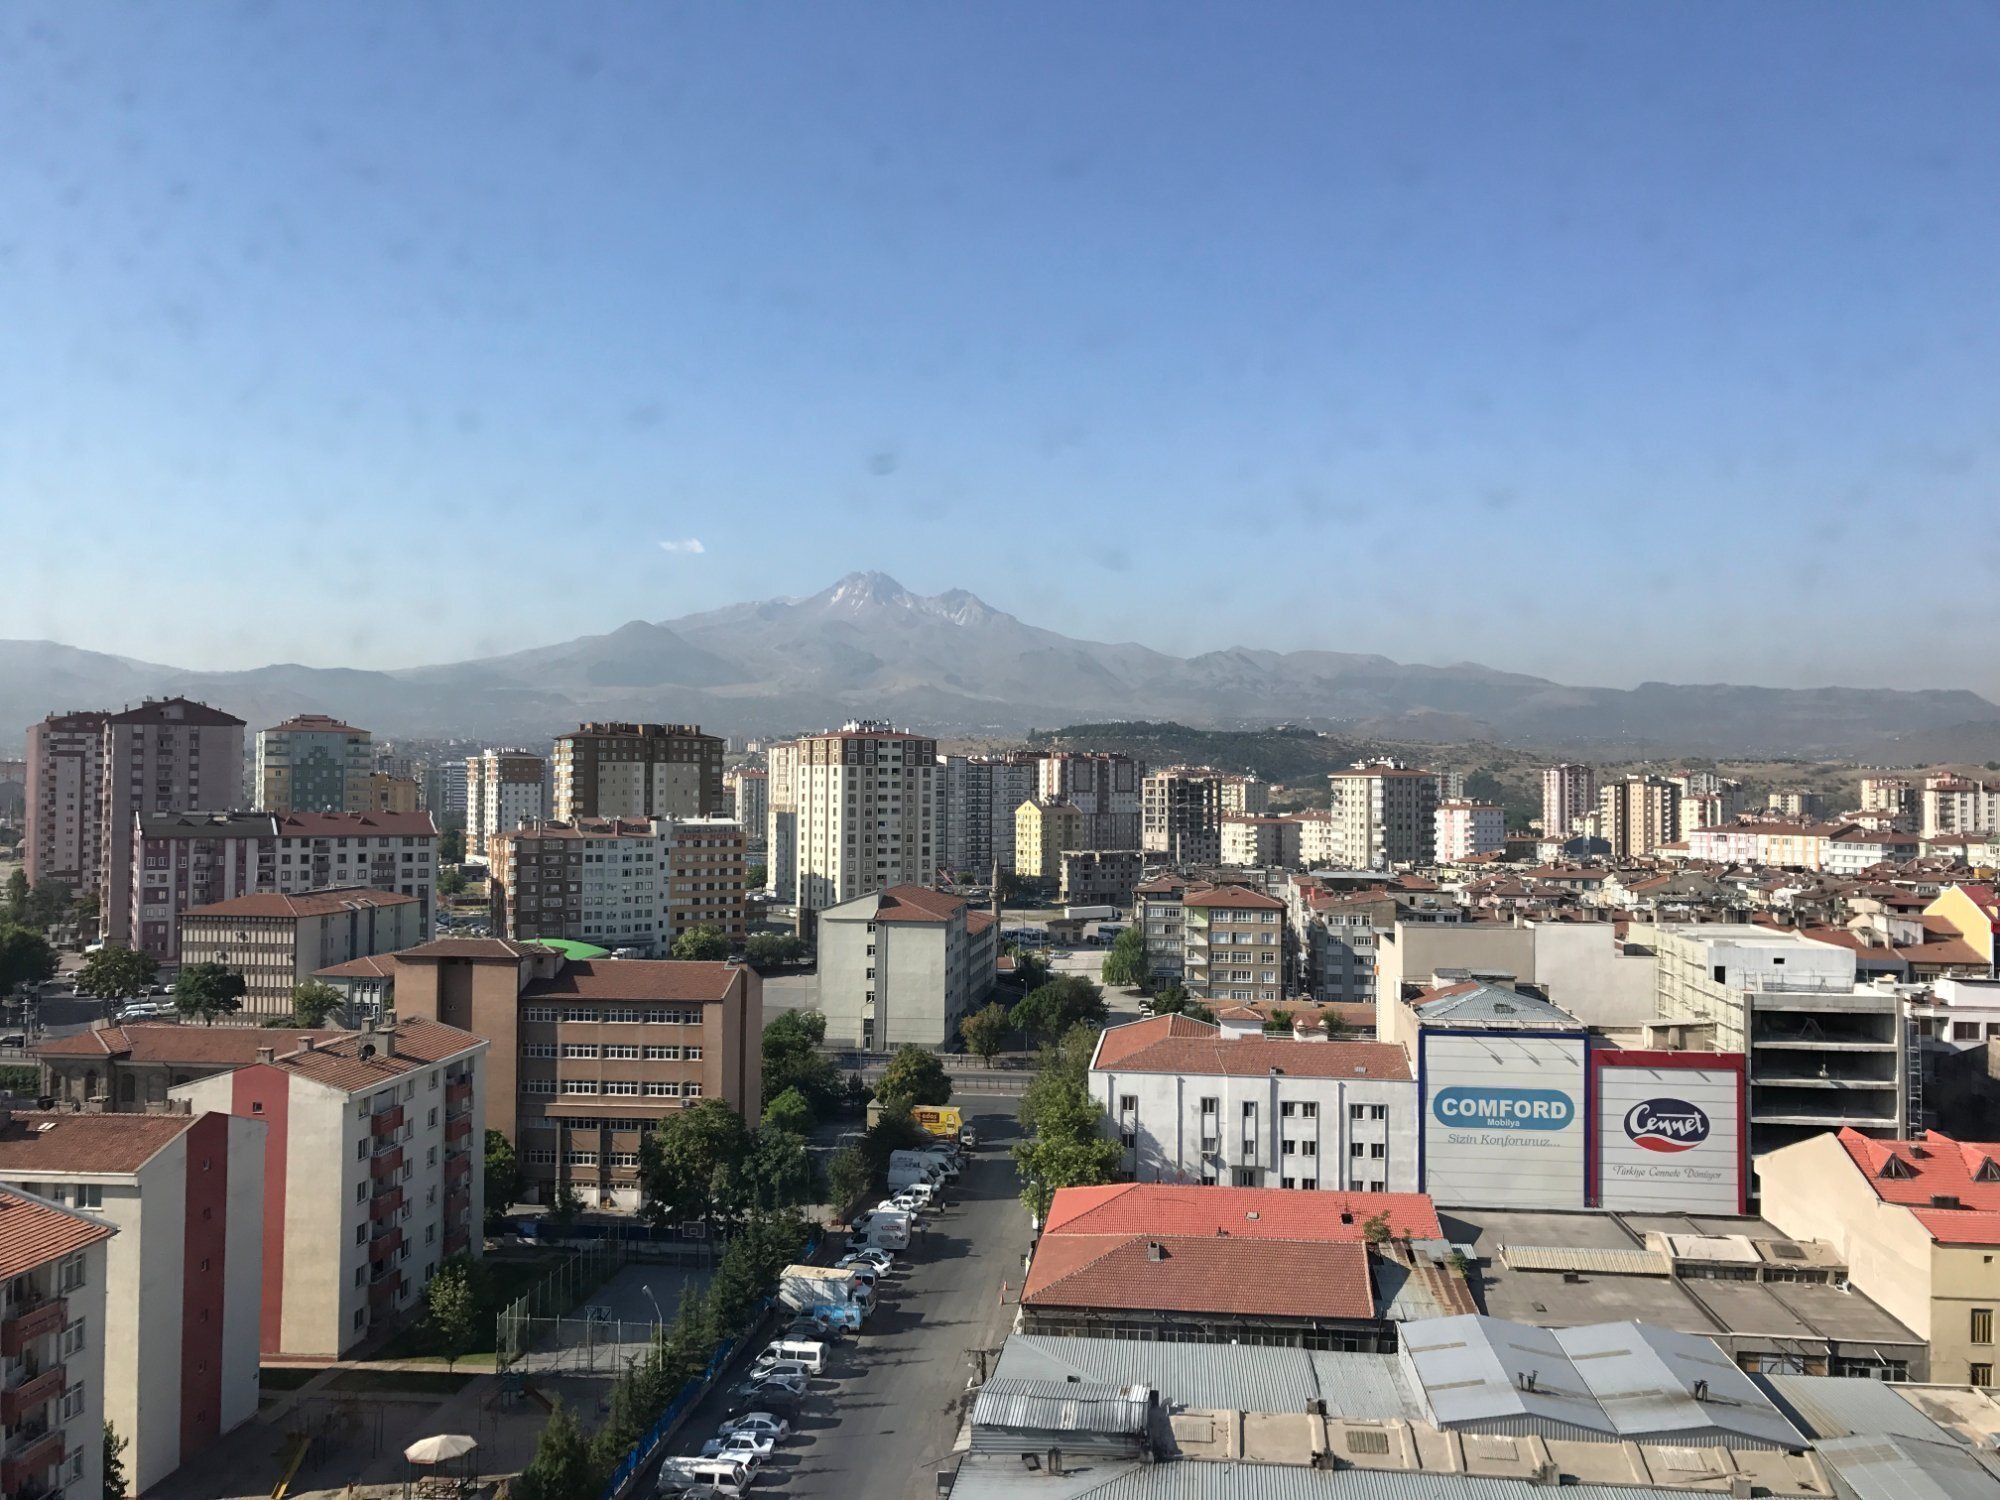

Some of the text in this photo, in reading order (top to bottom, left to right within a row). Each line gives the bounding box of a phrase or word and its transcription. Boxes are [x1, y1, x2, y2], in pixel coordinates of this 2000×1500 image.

[1441, 1097, 1567, 1119] COMFORD
[1487, 1118, 1520, 1128] Mobilya
[1629, 1103, 1705, 1136] Cennet
[1447, 1133, 1477, 1145] Sizin
[1612, 1165, 1646, 1178] Türkiye
